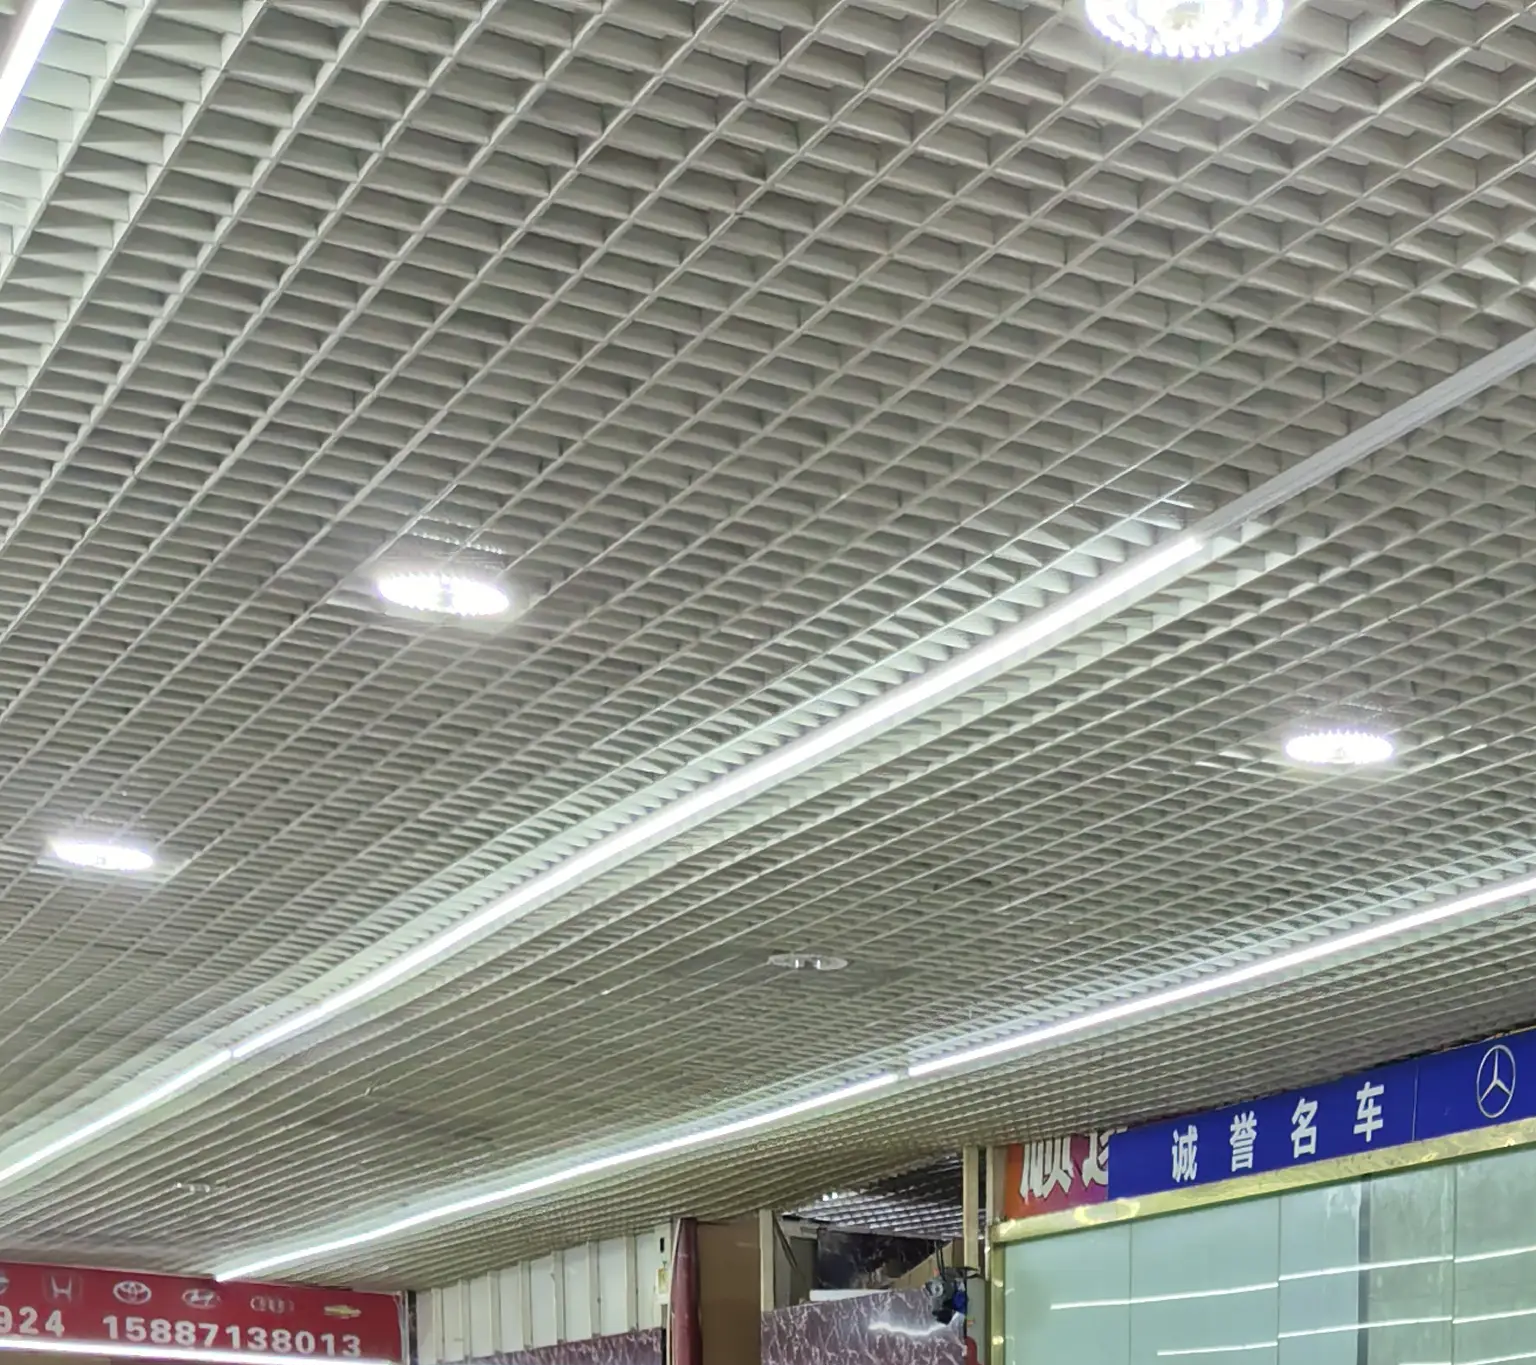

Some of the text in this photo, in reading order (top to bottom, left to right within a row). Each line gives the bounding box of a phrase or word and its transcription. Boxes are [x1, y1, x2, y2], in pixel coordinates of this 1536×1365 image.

[1171, 1081, 1385, 1183] 诚誉名车
[102, 1314, 362, 1358] 15887138013
